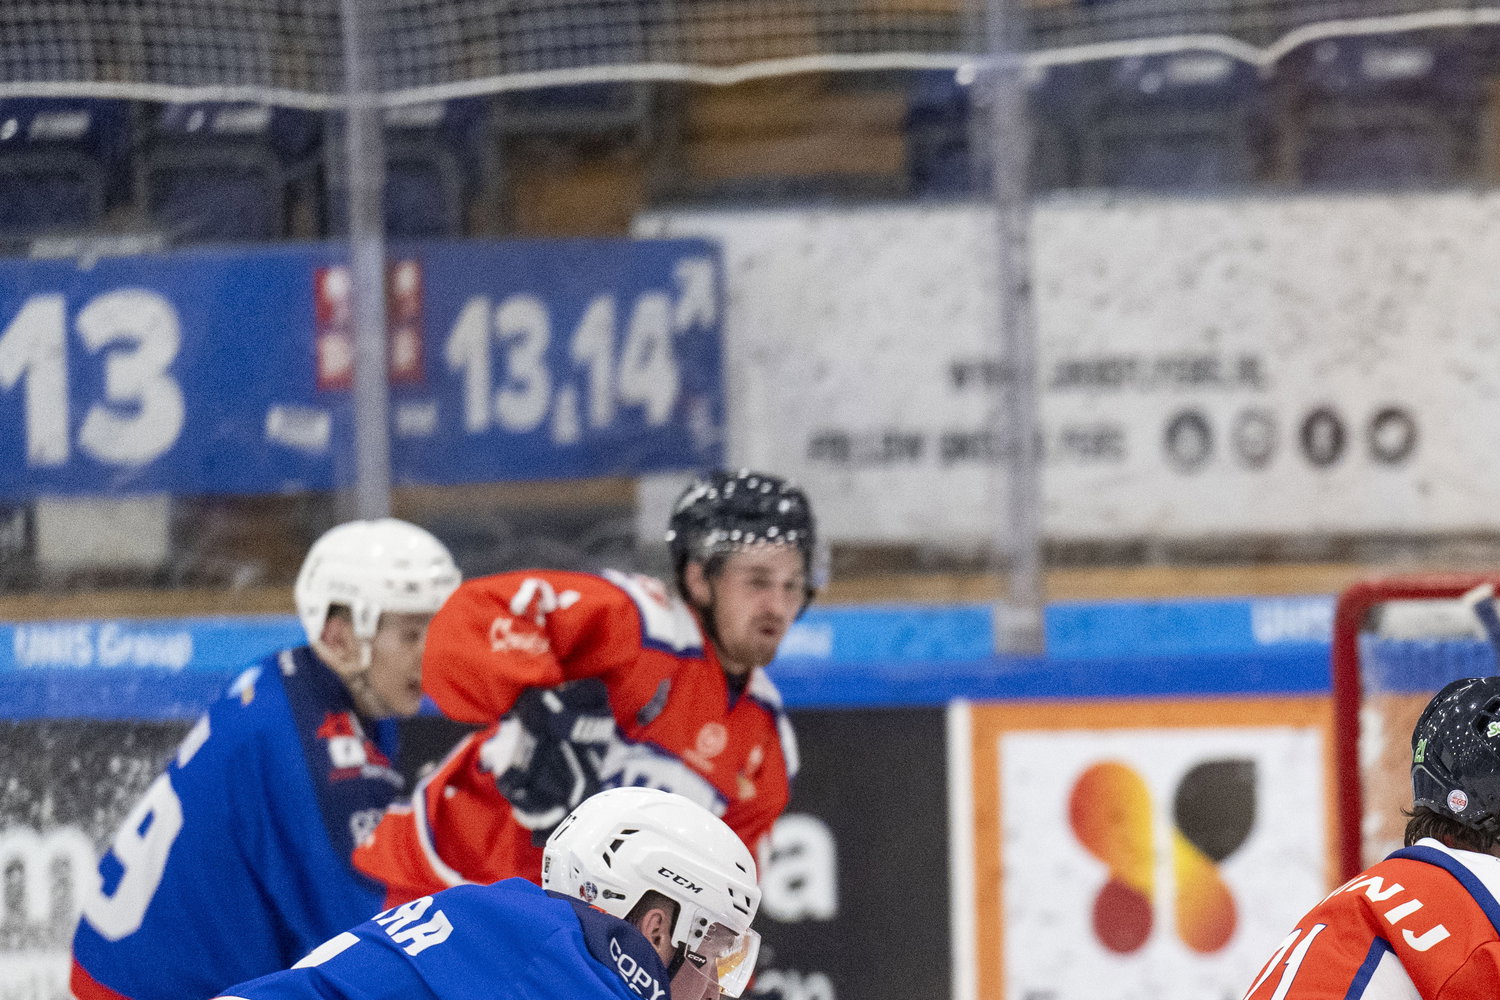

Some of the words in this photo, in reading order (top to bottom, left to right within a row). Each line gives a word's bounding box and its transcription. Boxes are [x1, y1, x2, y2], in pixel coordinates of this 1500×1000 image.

[0, 288, 186, 466] 13
[658, 866, 704, 895] CCM
[370, 895, 455, 957] AR
[1340, 874, 1451, 952] NIJ
[609, 937, 666, 996] COPY
[687, 951, 707, 964] CCM
